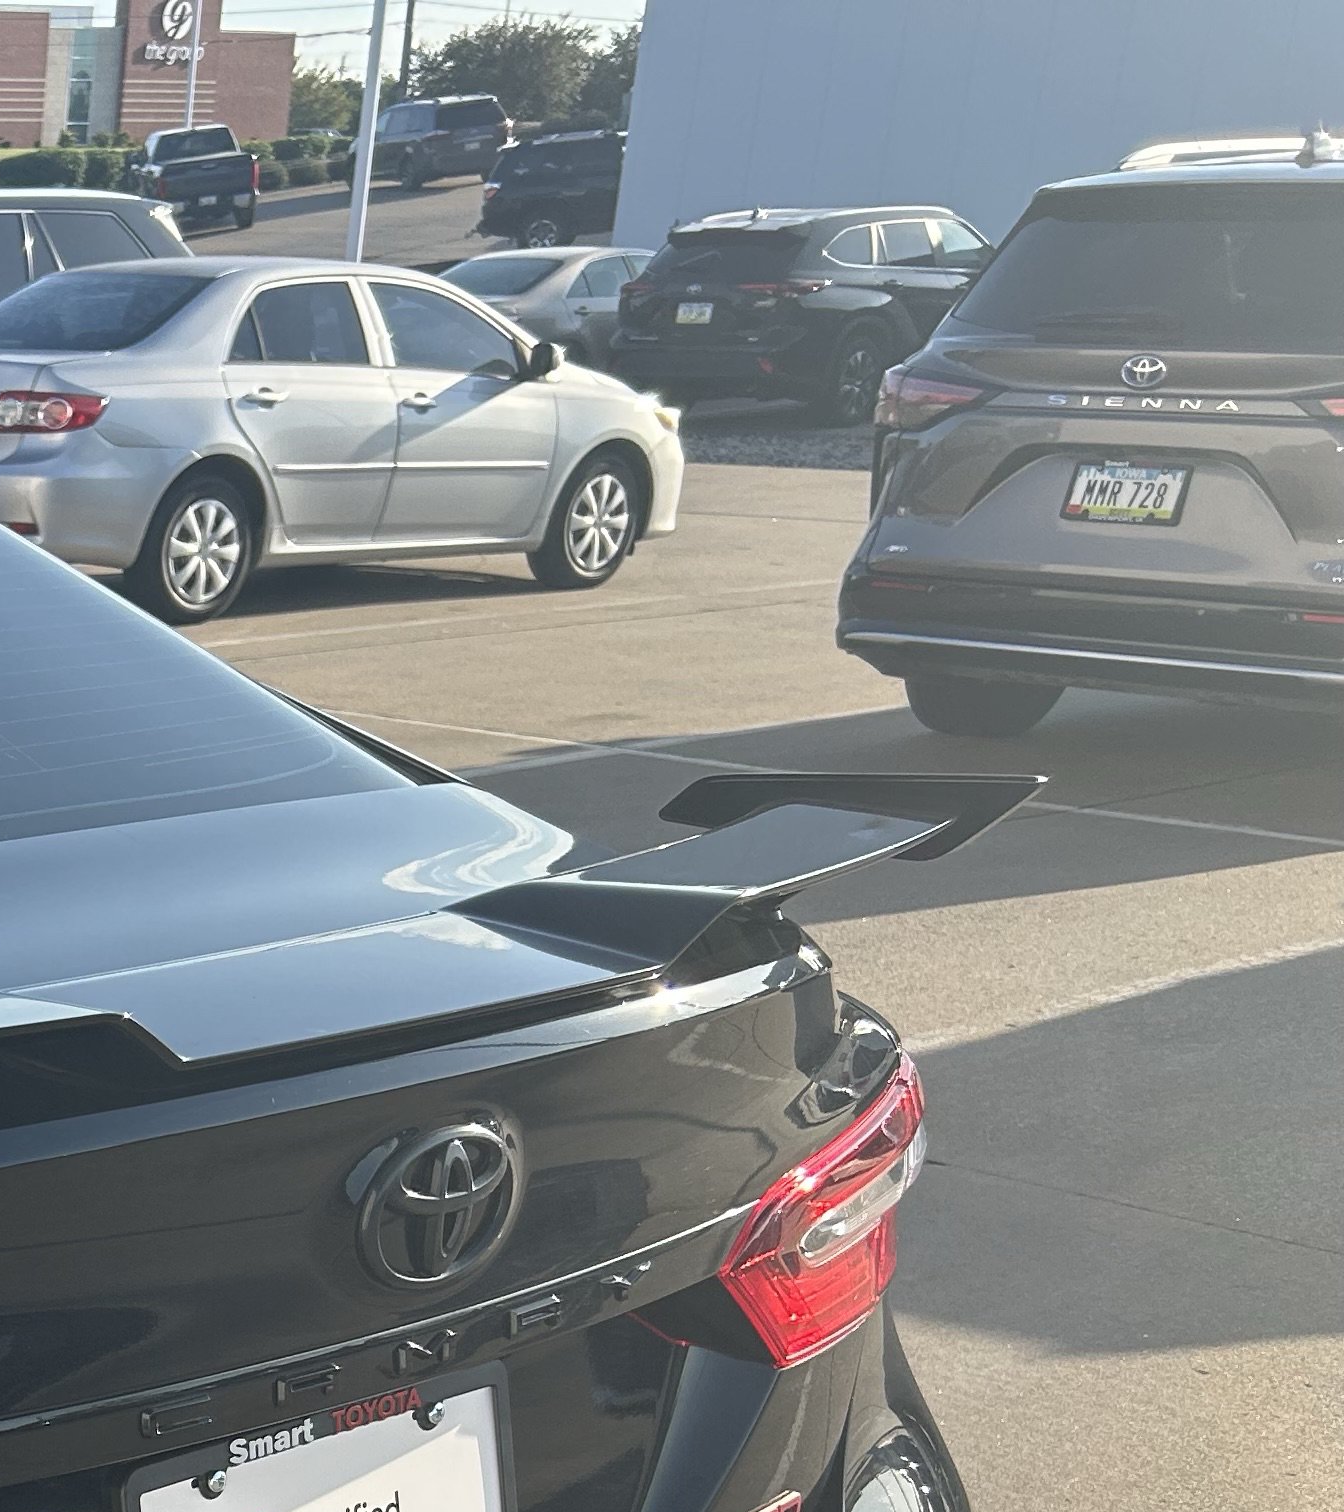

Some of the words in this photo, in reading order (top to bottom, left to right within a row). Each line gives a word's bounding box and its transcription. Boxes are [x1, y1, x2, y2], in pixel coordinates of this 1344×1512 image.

[1047, 393, 1240, 412] SIENNA
[1115, 468, 1147, 479] IOWA
[1081, 479, 1123, 506] MMR
[1127, 481, 1168, 508] 728
[228, 1418, 315, 1465] Smart
[330, 1387, 423, 1435] TOYOTA
